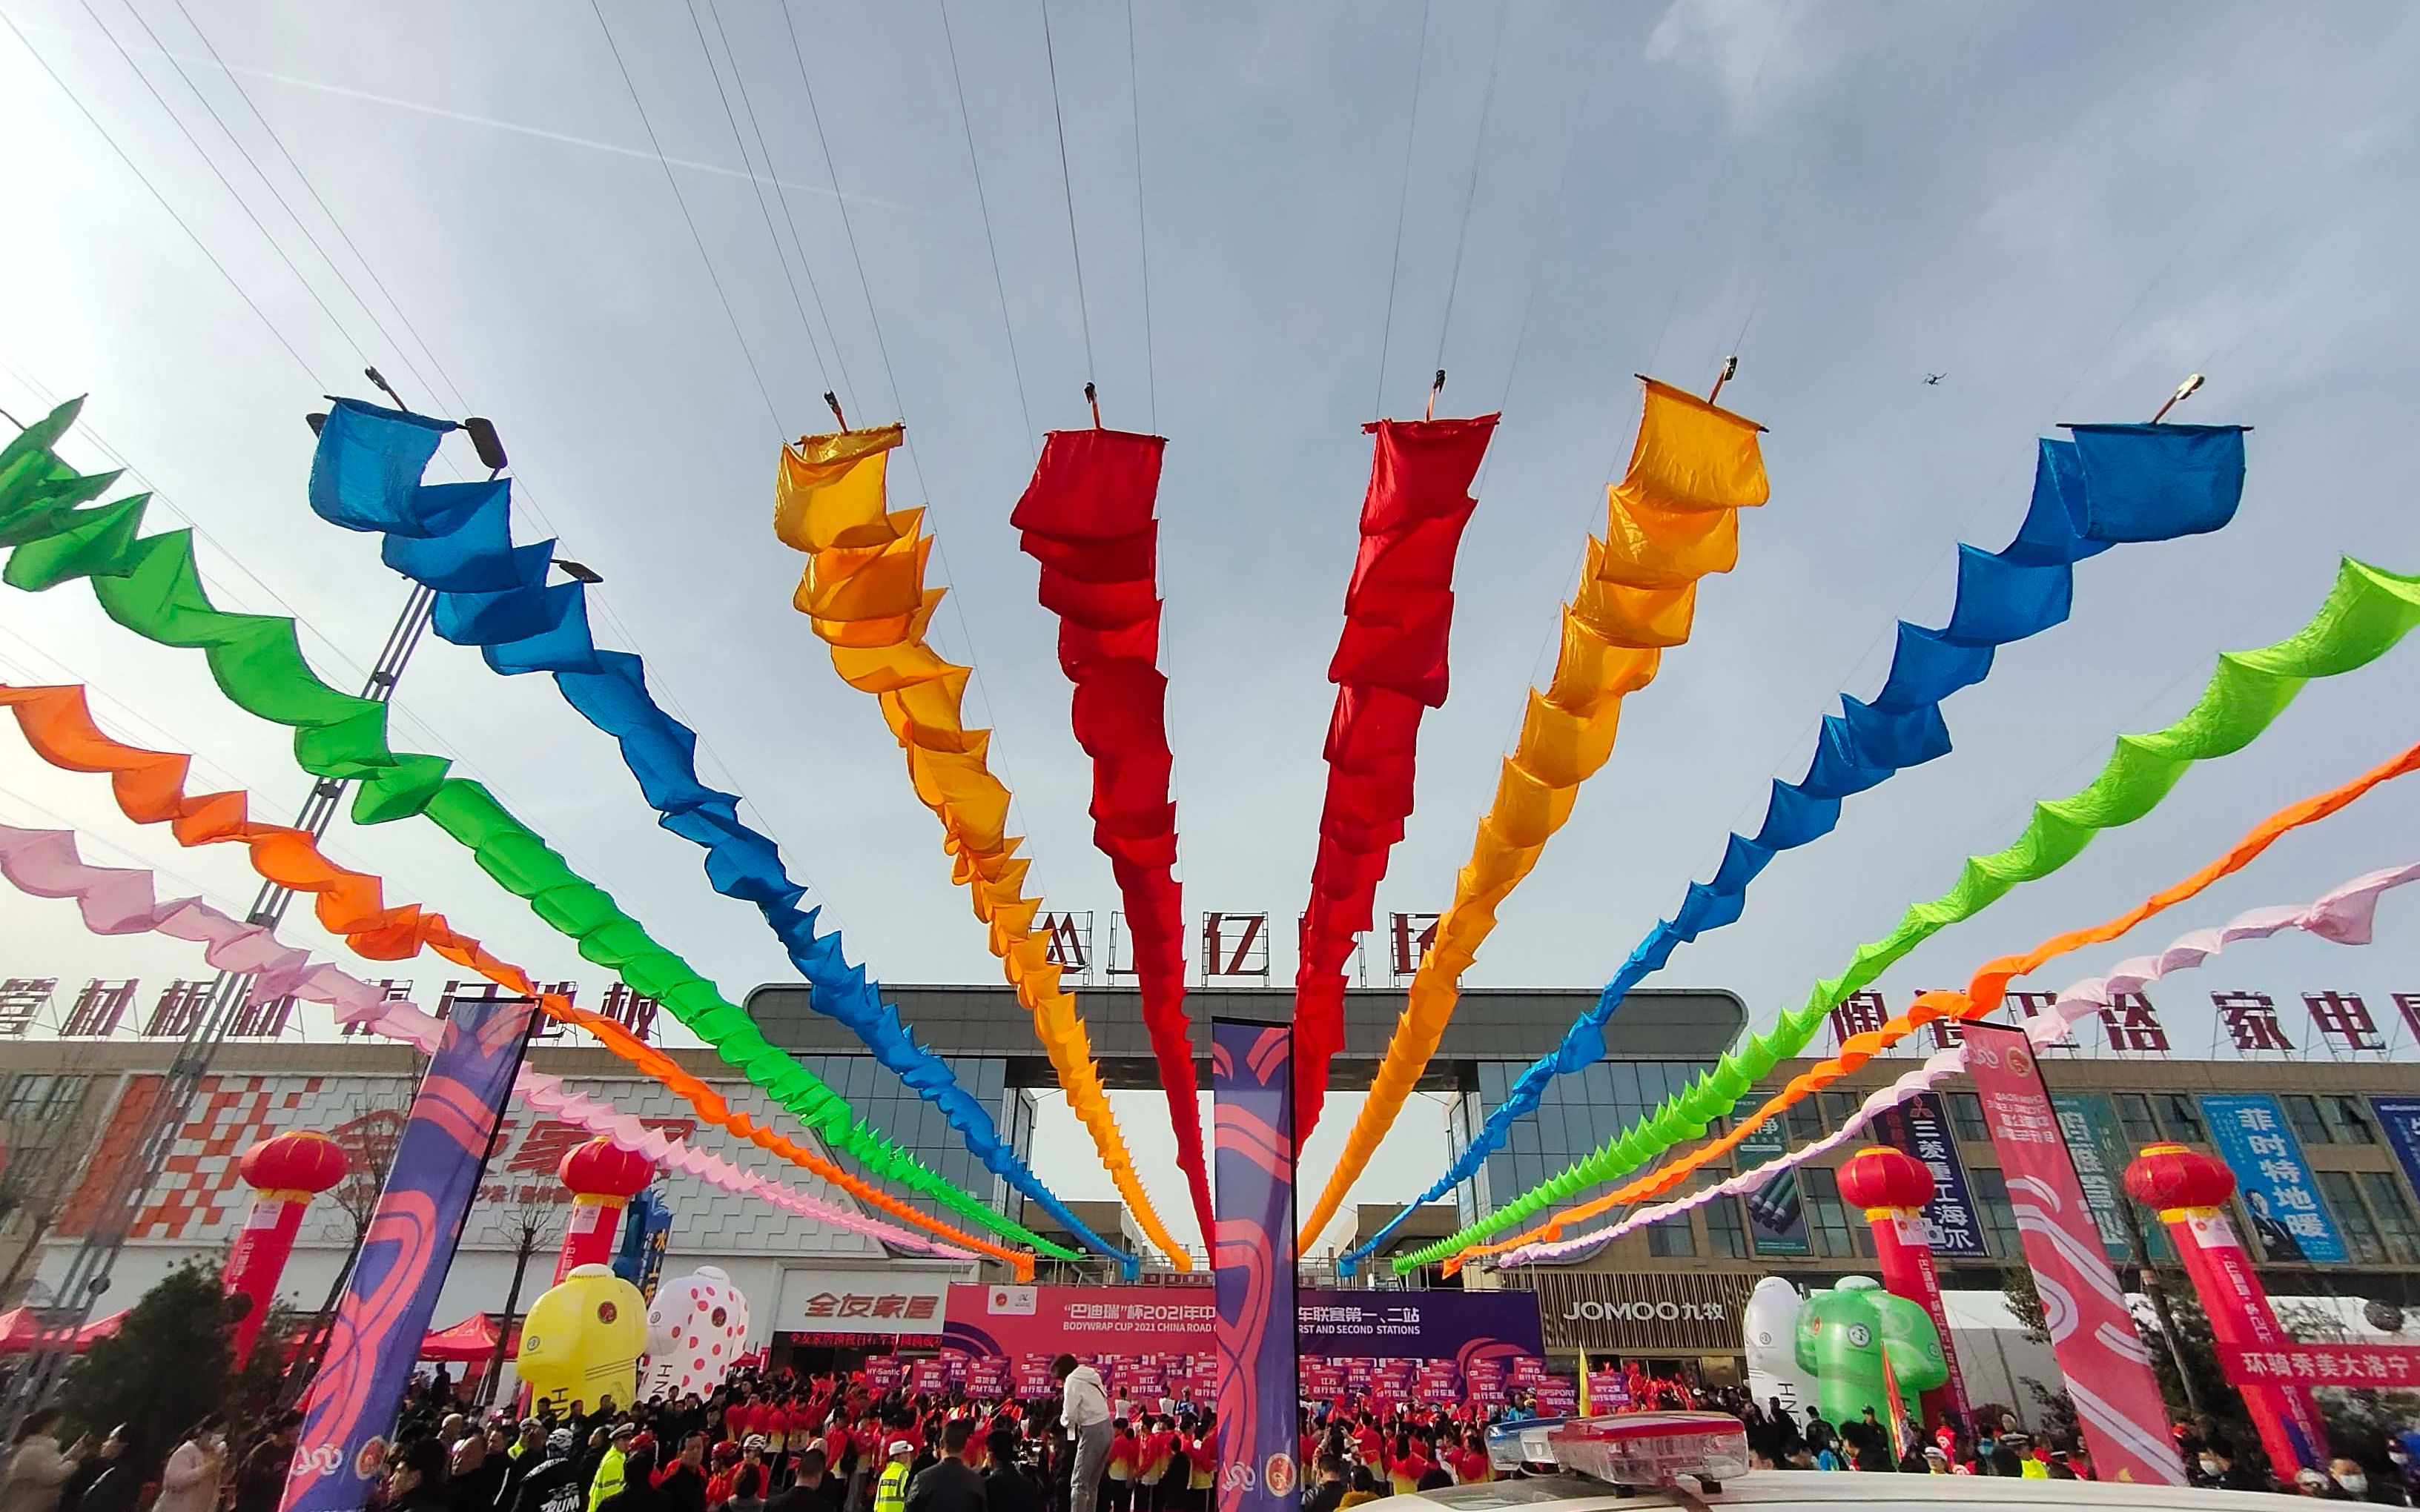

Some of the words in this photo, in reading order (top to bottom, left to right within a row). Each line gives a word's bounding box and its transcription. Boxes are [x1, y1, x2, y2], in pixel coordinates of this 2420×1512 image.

[1912, 1120, 1974, 1248] 三菱重工海尔
[804, 1292, 939, 1319] 全友家居
[1298, 1307, 1420, 1324] 车联赛第一、二站
[1563, 1301, 1679, 1321] JOMOO
[1681, 1302, 1725, 1320] 九牧
[1062, 1322, 1113, 1331] BODYWRAP
[1114, 1322, 1133, 1331] CUP
[1134, 1322, 1155, 1332] 2021
[1157, 1323, 1186, 1333] CHINA
[1186, 1324, 1211, 1333] ROAD
[1315, 1324, 1335, 1334] AND
[1336, 1325, 1373, 1334] SECOND
[1376, 1325, 1421, 1335] STATIONS
[2241, 1352, 2420, 1378] 环骑秀美大洛宁
